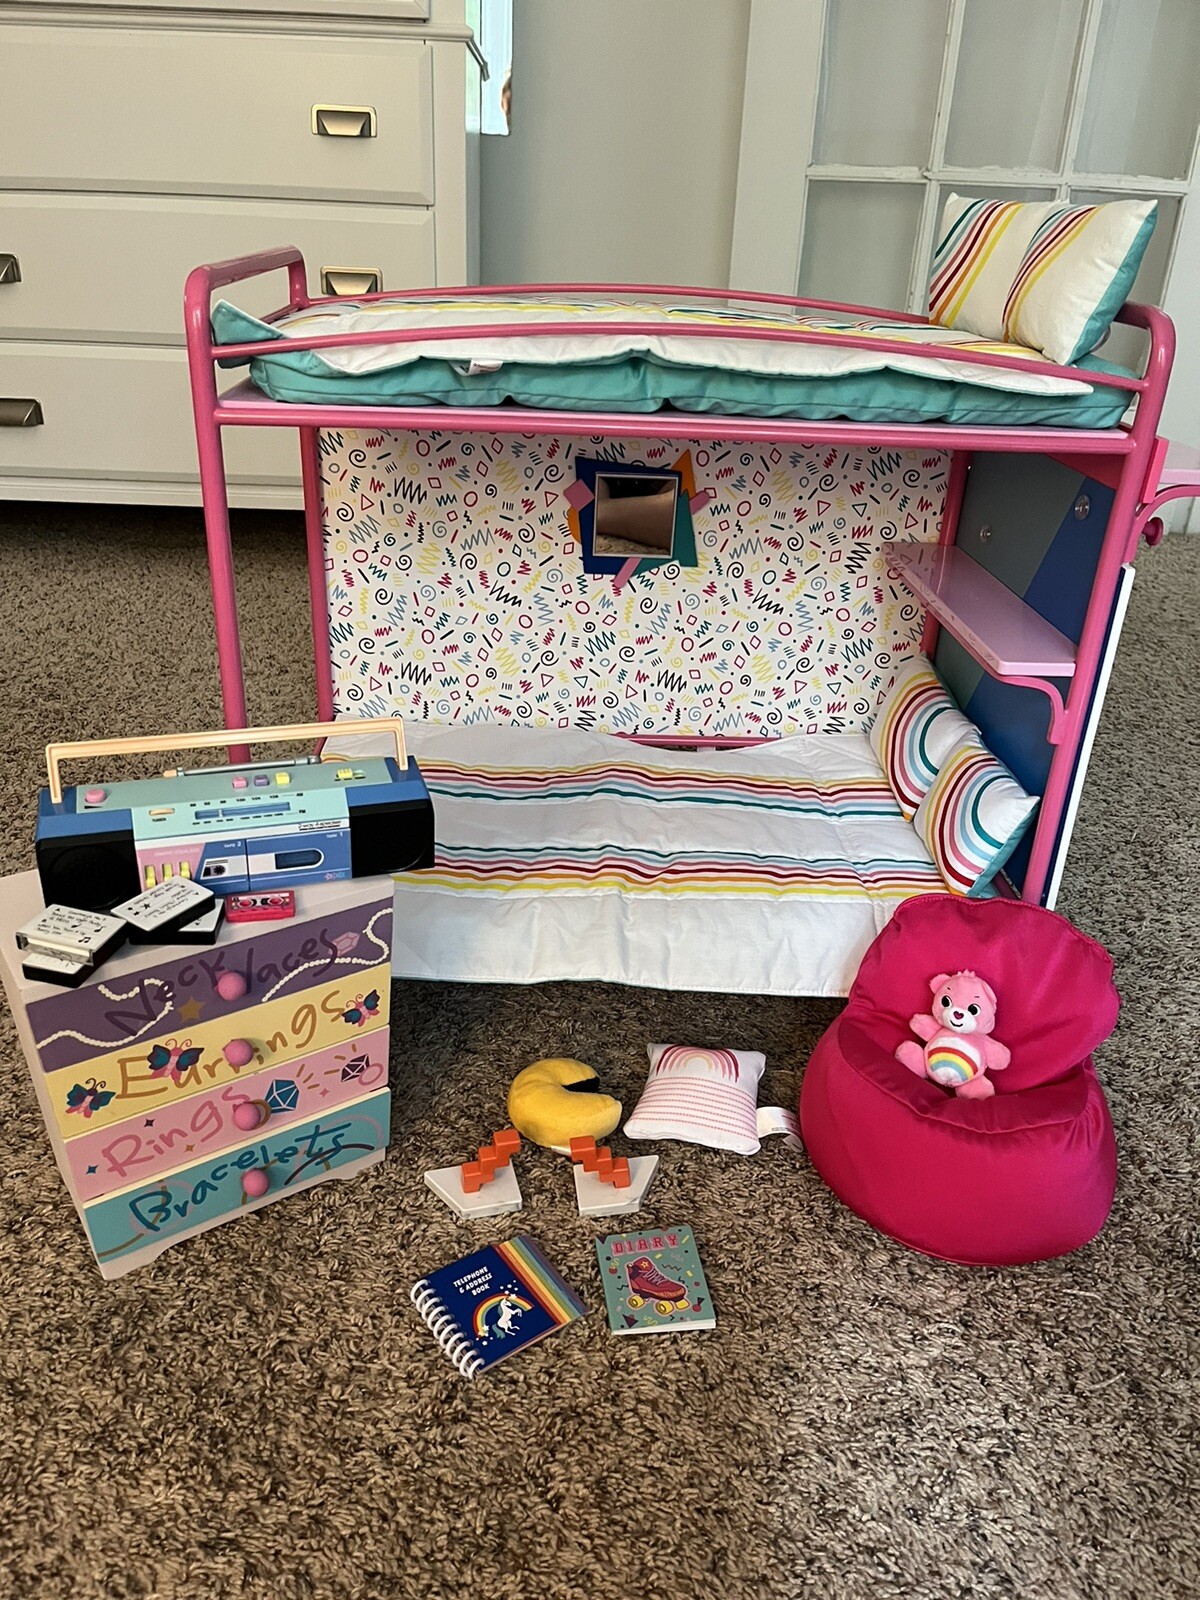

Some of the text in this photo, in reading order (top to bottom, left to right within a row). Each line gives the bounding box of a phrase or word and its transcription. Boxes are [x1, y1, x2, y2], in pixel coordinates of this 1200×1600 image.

[102, 1086, 251, 1178] Rings
[129, 1123, 352, 1232] Bracelets
[611, 1234, 678, 1256] DIARY
[453, 1266, 489, 1288] TELEPHONE
[465, 1272, 493, 1291] ADDRESS
[471, 1283, 491, 1296] BOOK
